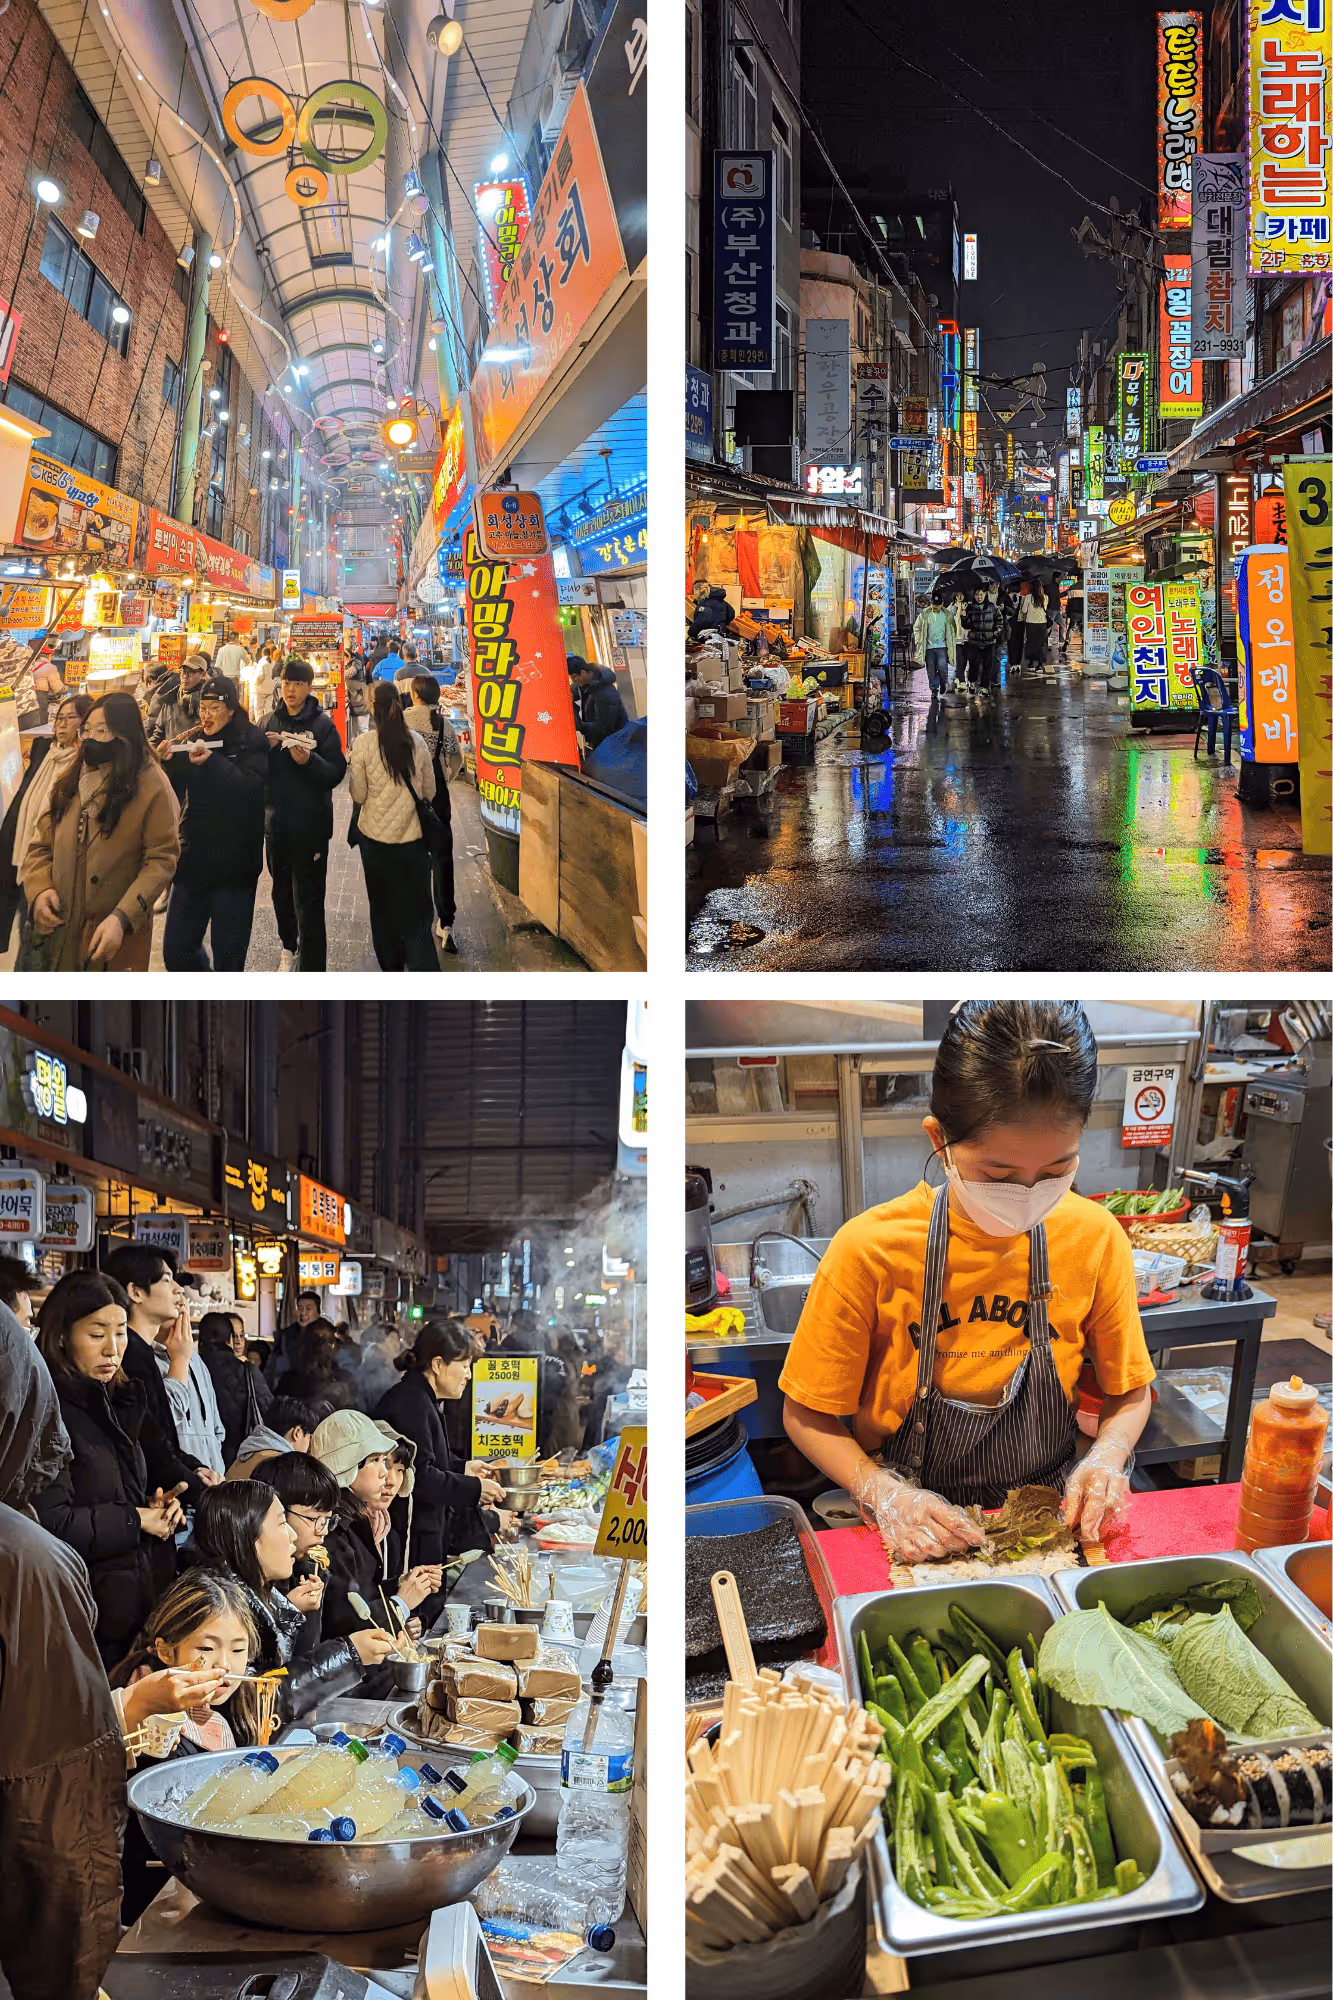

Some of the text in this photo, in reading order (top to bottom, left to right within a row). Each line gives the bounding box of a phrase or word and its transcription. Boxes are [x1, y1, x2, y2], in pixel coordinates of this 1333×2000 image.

[1267, 218, 1327, 240] 카페
[1261, 251, 1284, 266] 2F
[1166, 269, 1191, 282] 자갈
[1204, 206, 1235, 335] 대림참치
[1194, 339, 1244, 352] 231-9931
[41, 468, 58, 486] KBS
[487, 513, 541, 529] 회성상회
[1129, 585, 1169, 708] 여인천지
[1254, 564, 1297, 752] 정오뎅바
[1132, 1068, 1175, 1082] 금연구역
[971, 1350, 986, 1358] me
[989, 1346, 1029, 1359] anything
[501, 1359, 520, 1370] 호떡
[489, 1371, 520, 1380] 2500원
[478, 1434, 523, 1446] 치즈호떡
[489, 1448, 519, 1457] 3000원
